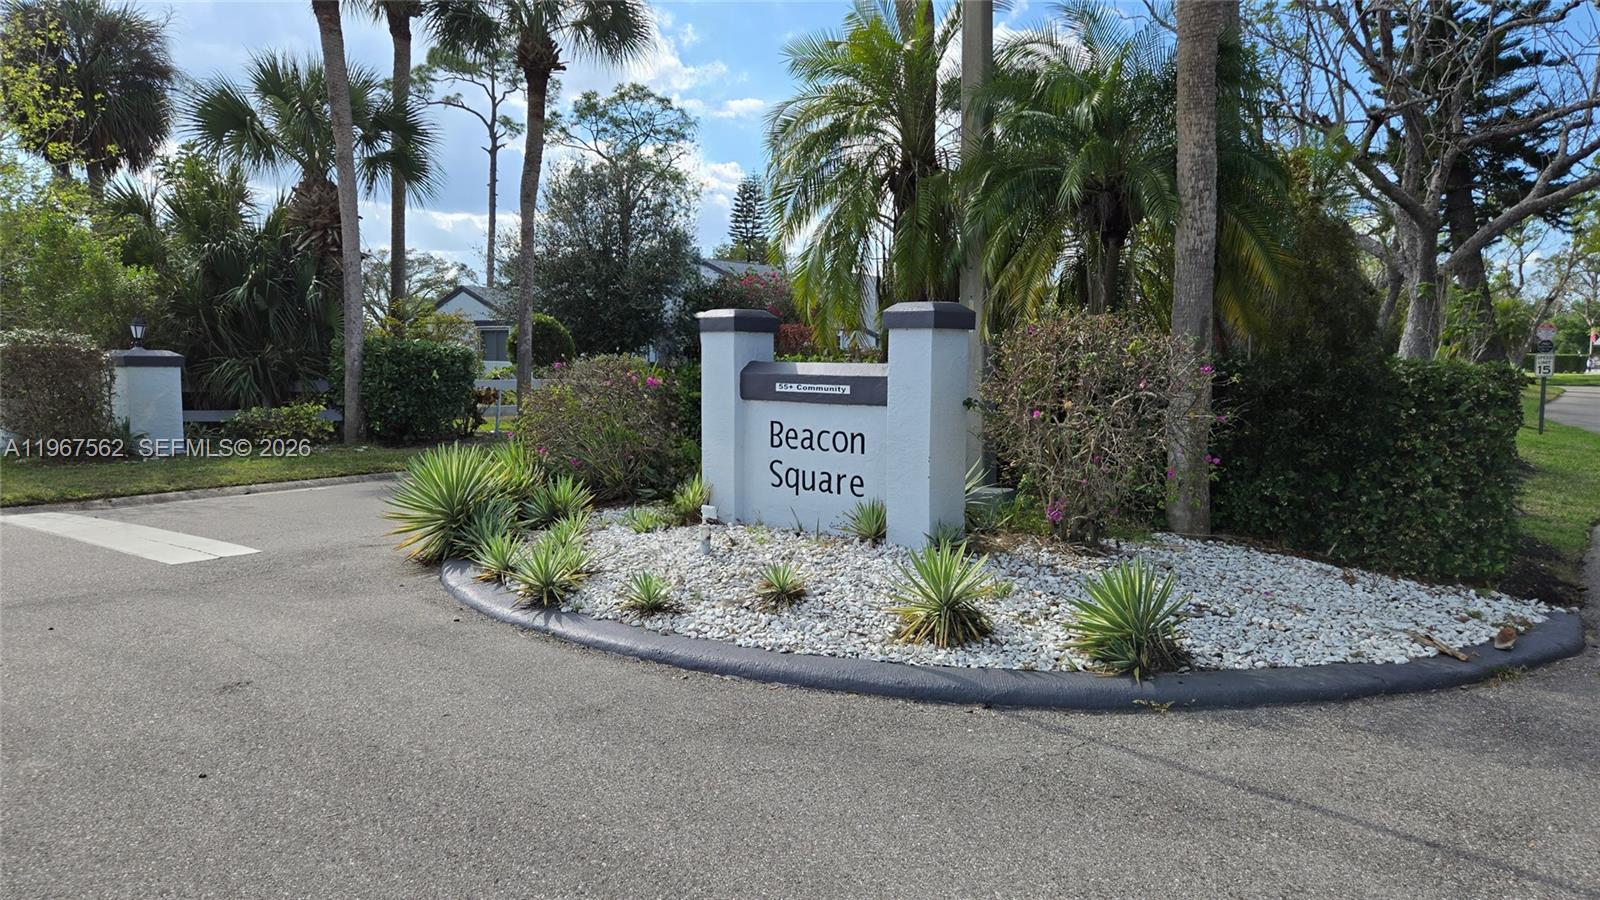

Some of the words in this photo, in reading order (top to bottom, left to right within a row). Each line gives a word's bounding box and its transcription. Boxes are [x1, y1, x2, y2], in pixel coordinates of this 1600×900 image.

[1537, 365, 1551, 375] 15
[796, 384, 847, 394] Community
[770, 420, 865, 455] Beacon
[769, 459, 865, 498] Square
